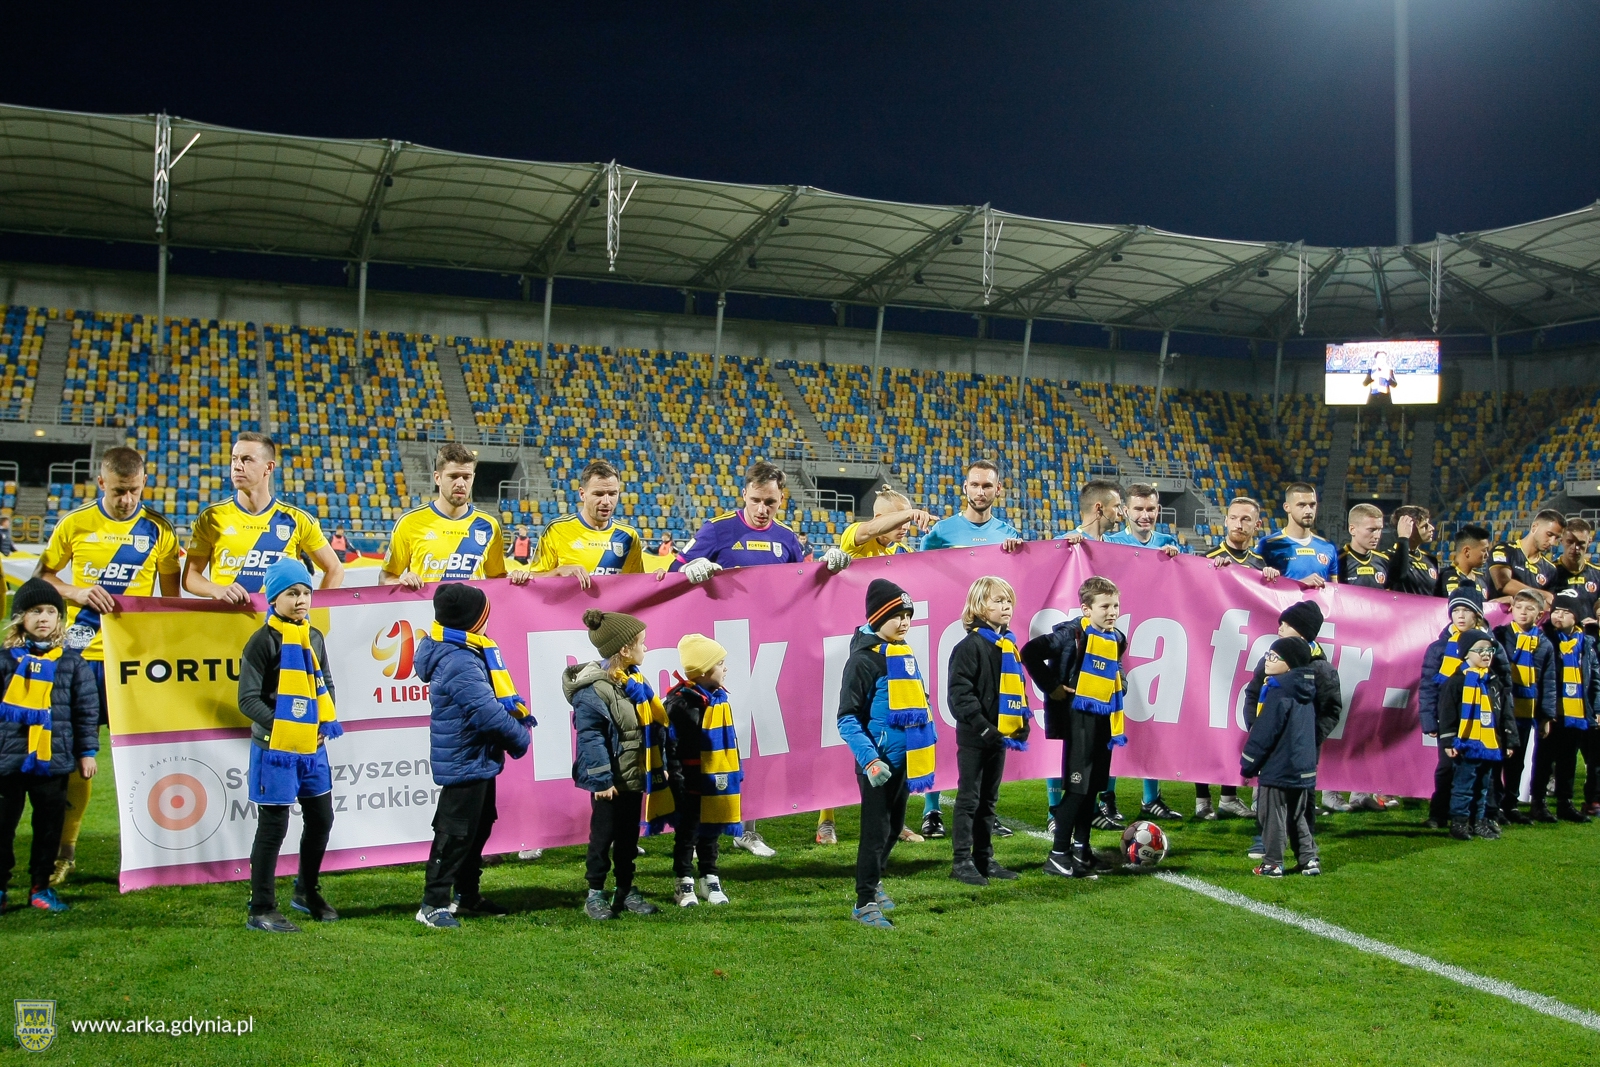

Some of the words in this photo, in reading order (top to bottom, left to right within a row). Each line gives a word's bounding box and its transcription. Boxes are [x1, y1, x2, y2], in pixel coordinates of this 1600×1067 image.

[501, 448, 512, 458] 16
[864, 466, 875, 474] 17
[1173, 480, 1182, 489] 18
[423, 553, 484, 572] forBET
[83, 562, 144, 581] forBET
[1092, 659, 1106, 670] TAG
[119, 658, 241, 685] FORTU
[1209, 608, 1374, 740] fr
[373, 687, 382, 703] 1
[1007, 700, 1021, 710] TAG
